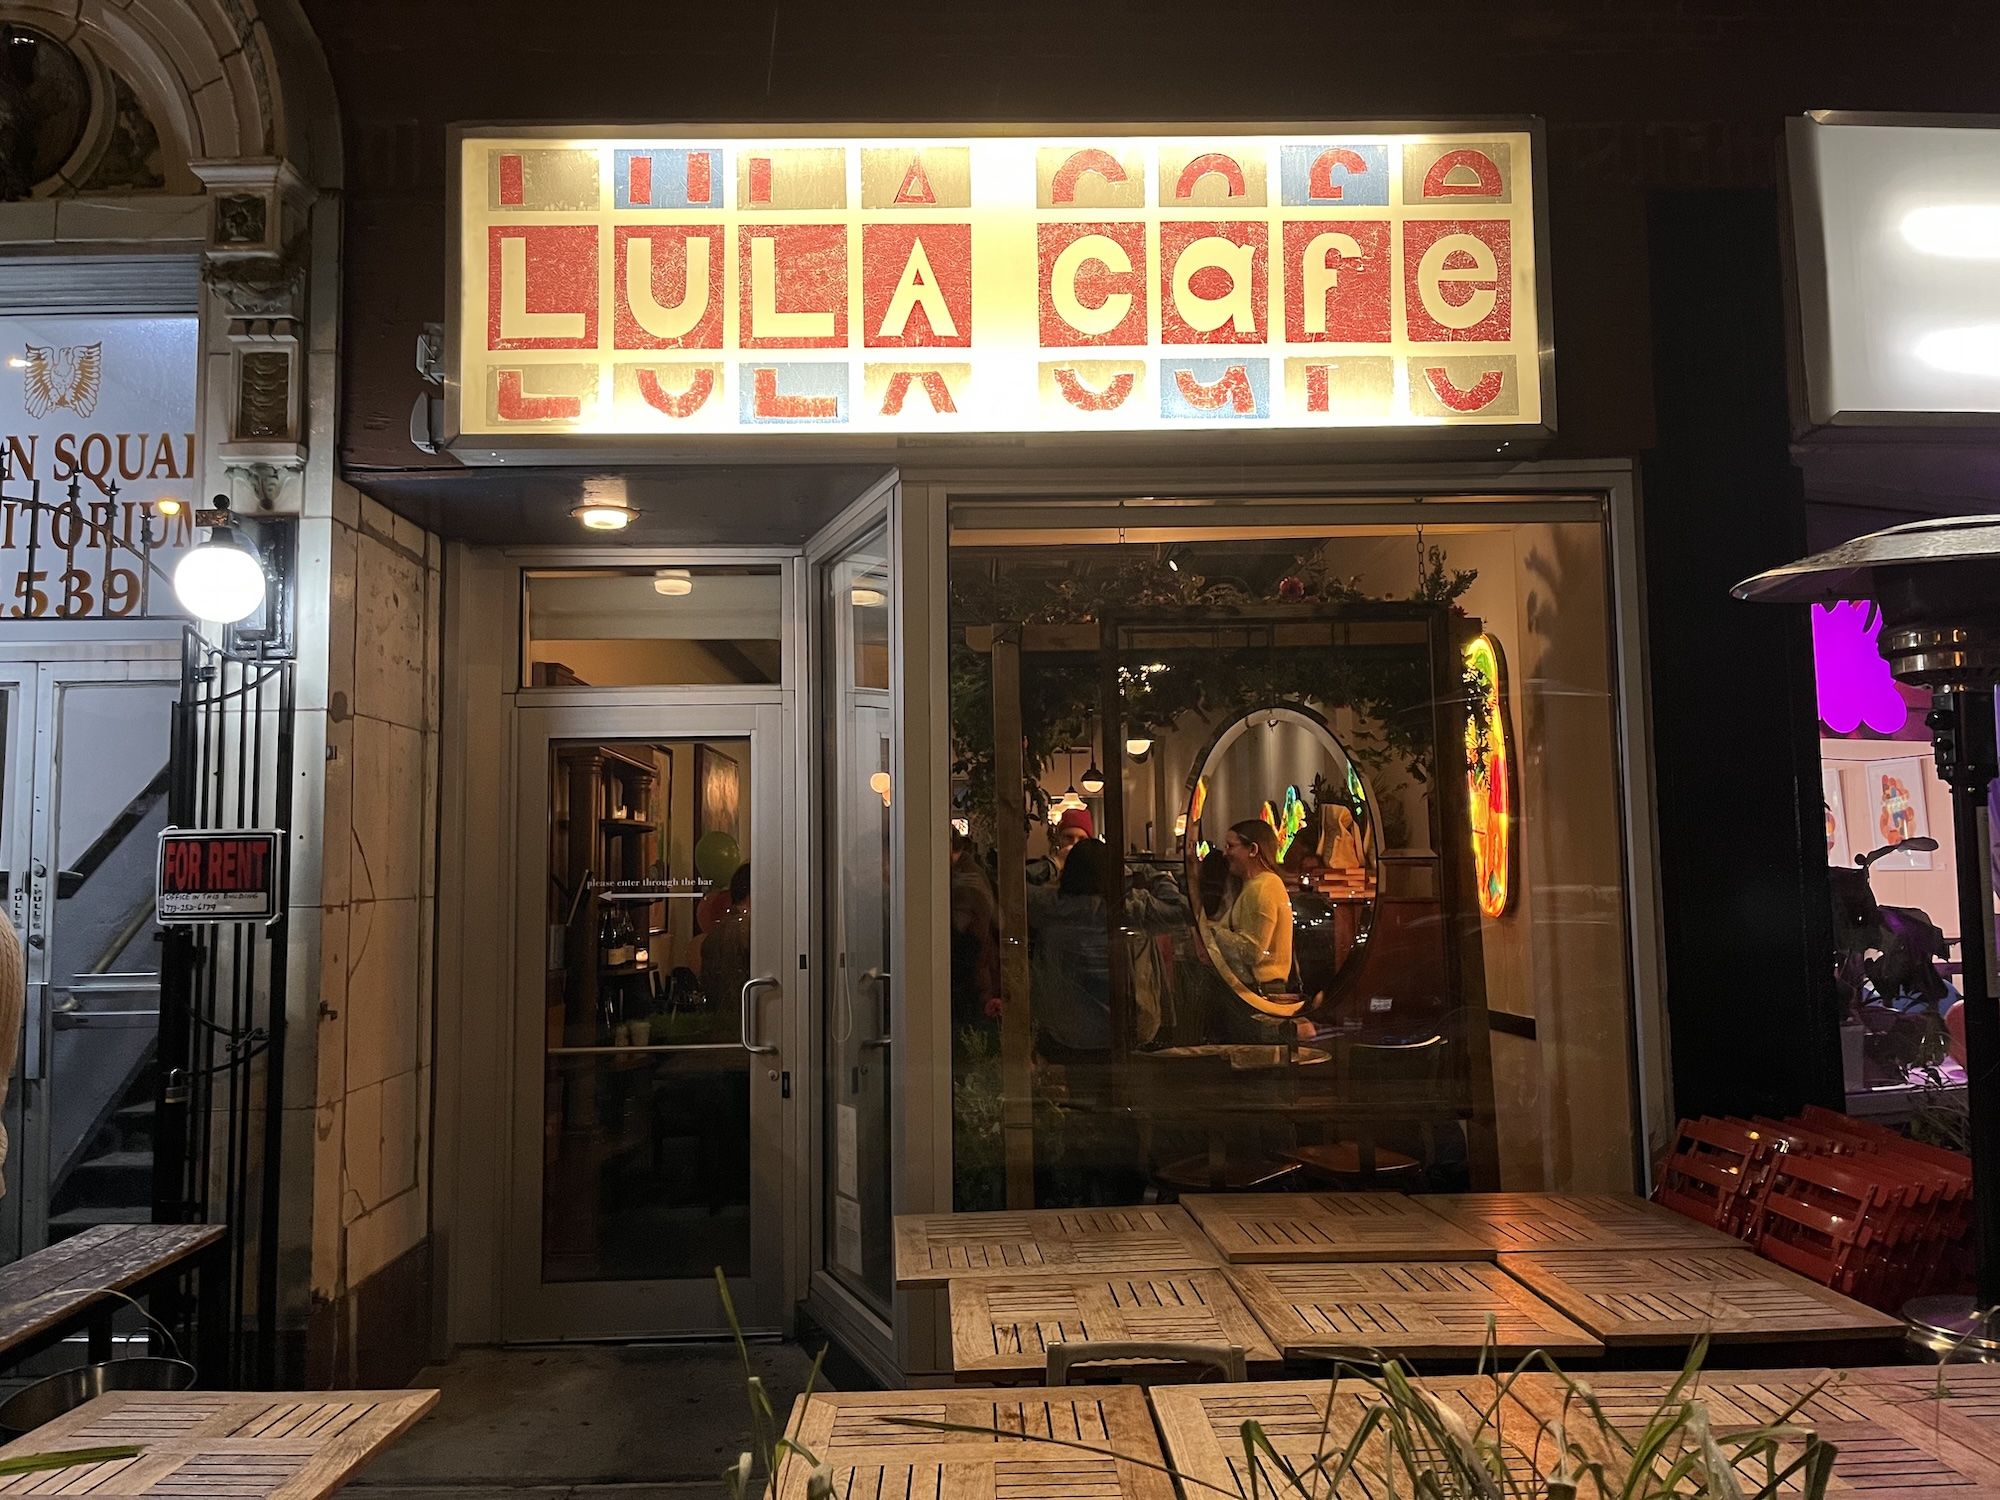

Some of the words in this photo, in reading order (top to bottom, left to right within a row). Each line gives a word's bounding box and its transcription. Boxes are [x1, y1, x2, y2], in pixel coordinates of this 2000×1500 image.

[500, 235, 959, 339] LULA
[166, 841, 200, 890] FOR
[208, 841, 267, 889] RENT
[165, 892, 190, 901] OFFICE
[203, 892, 219, 900] THIS
[586, 878, 615, 889] please
[616, 879, 640, 887] enter
[642, 877, 679, 888] through
[681, 877, 696, 886] the
[697, 877, 713, 886] bar
[14, 888, 23, 916] PULL
